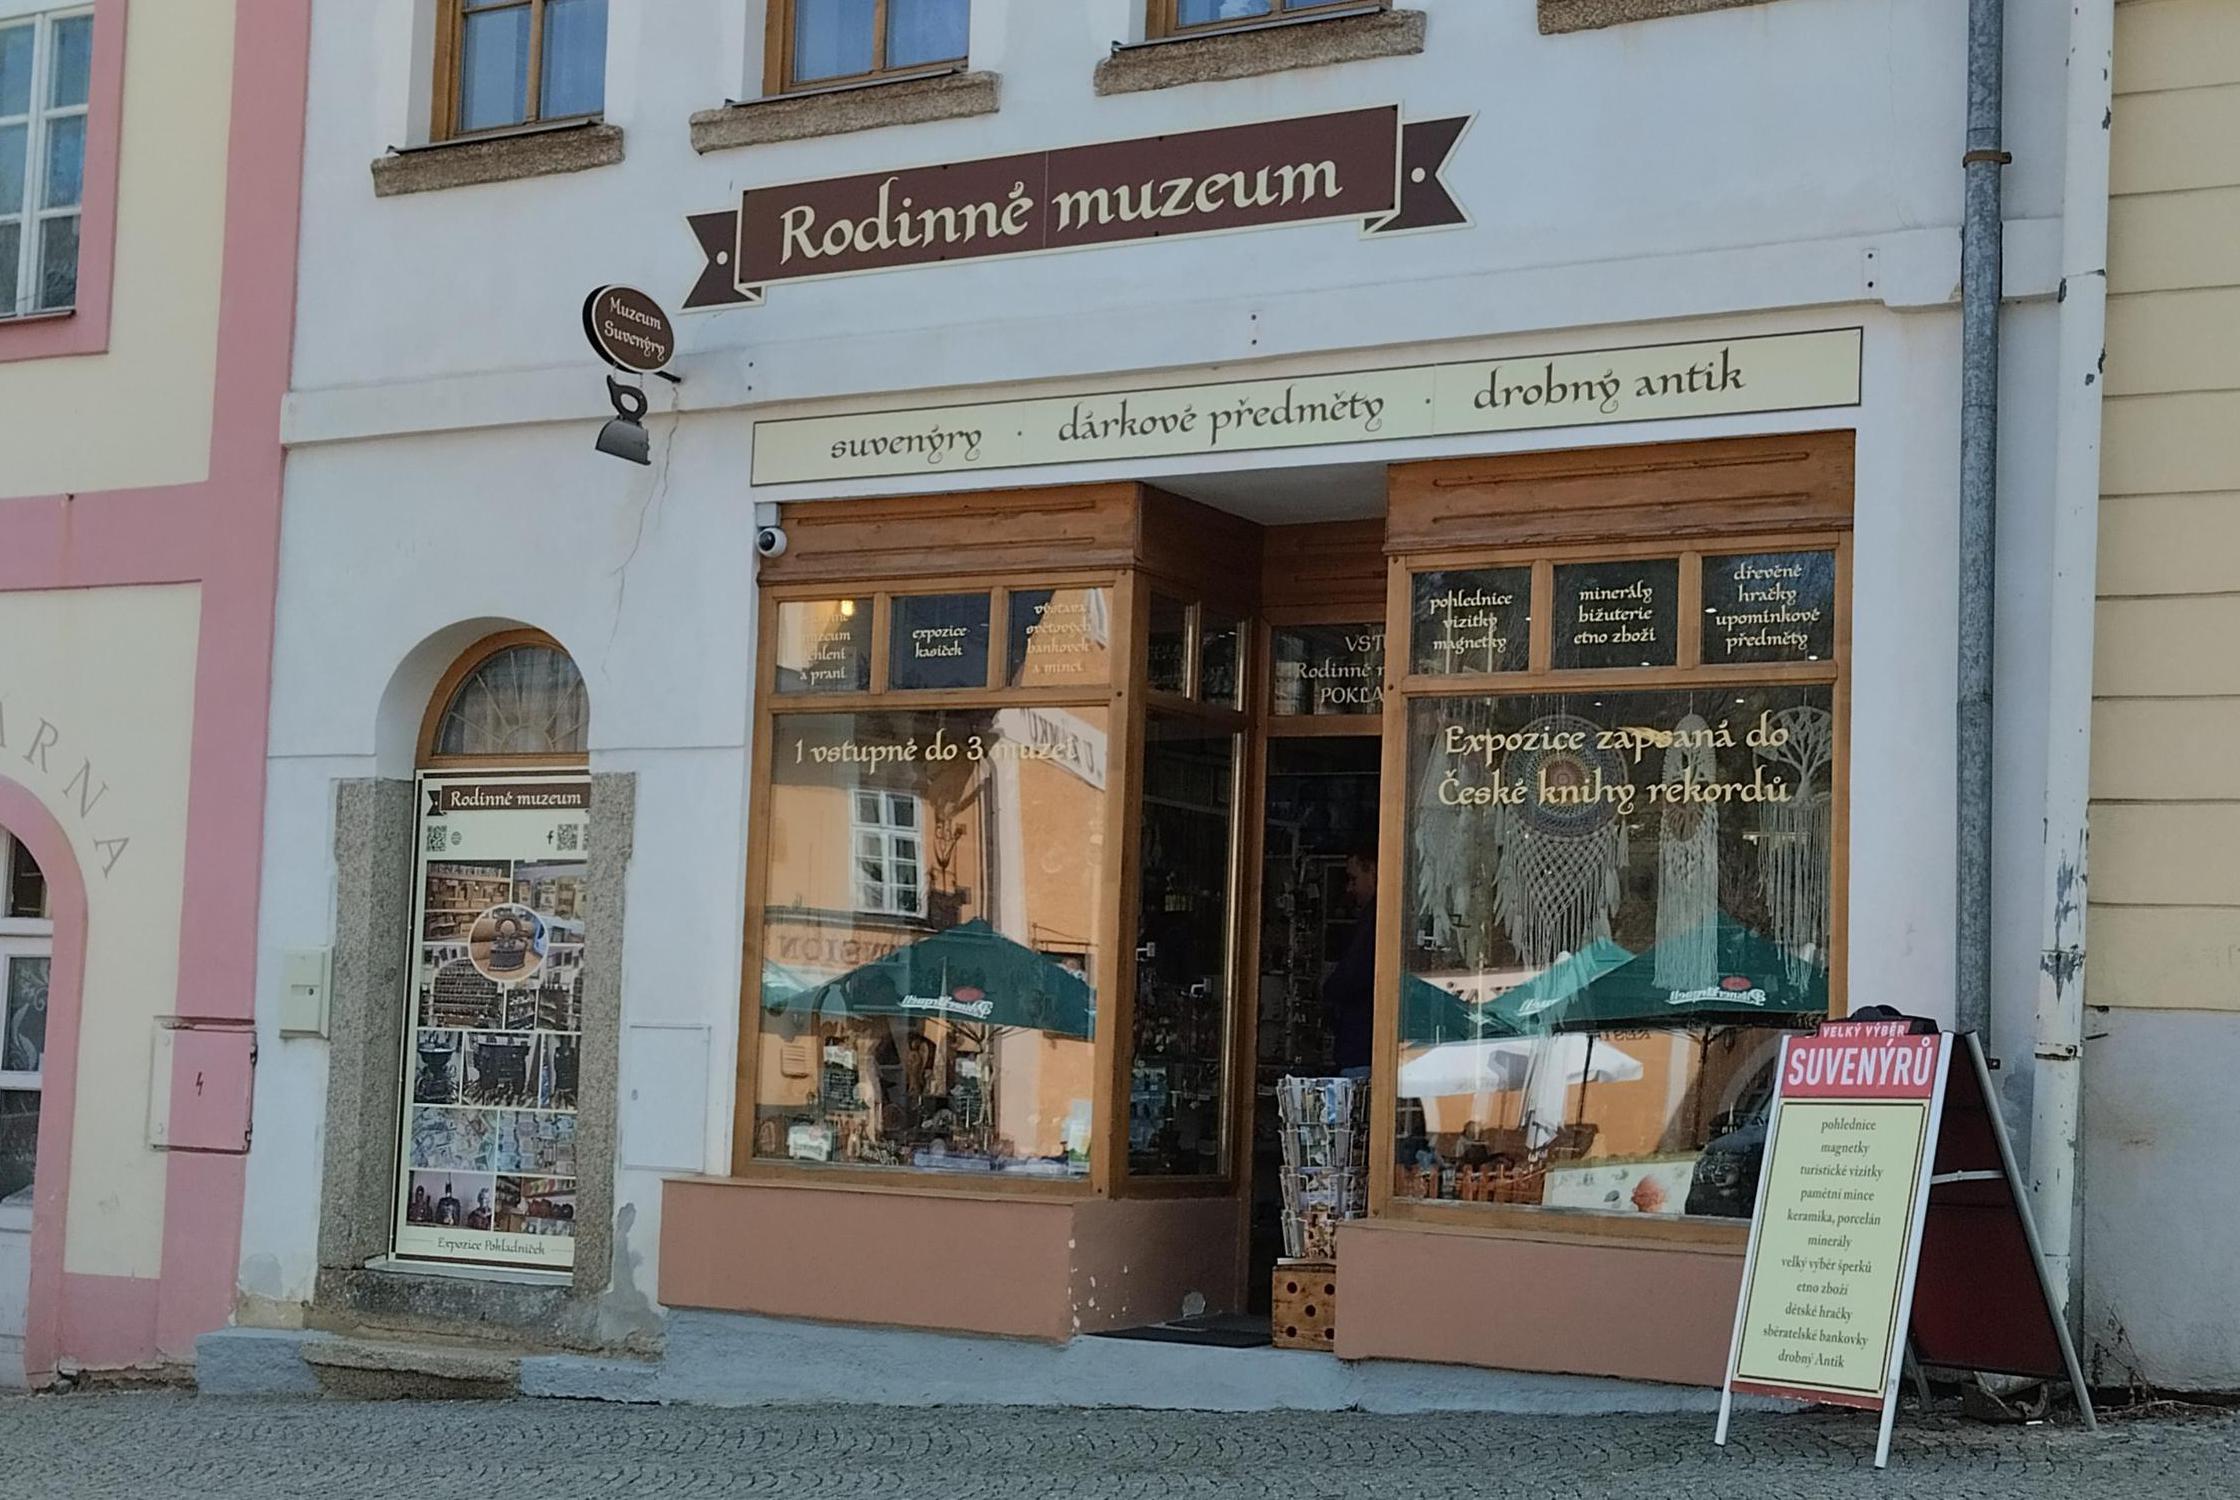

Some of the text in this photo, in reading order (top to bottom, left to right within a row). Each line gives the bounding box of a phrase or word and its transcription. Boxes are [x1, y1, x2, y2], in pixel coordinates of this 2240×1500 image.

[779, 157, 1343, 265] Rodinné muzeum
[609, 296, 661, 331] Muzeum
[604, 320, 665, 362] Suvenýry
[831, 346, 1746, 464] suvenýry dárkové předměty drobný antik
[1733, 562, 1803, 580] dřevěné
[1430, 588, 1513, 615] pohlednice
[1579, 579, 1653, 604] minerály
[1739, 582, 1798, 606] hračky
[1443, 609, 1498, 632] vizitky
[1578, 604, 1653, 623] bižuterie
[1716, 604, 1821, 632] upomínkové
[912, 625, 967, 644] expozice
[1574, 624, 1657, 644] etno zboží
[1725, 627, 1808, 655] předměty
[915, 640, 964, 659] kasiček
[1433, 636, 1507, 655] magnetky
[800, 666, 846, 686] a praní
[1298, 656, 1371, 679] Rodinné
[1445, 709, 1790, 768] Expozice zapsaná do
[810, 738, 918, 775] vstupné
[925, 728, 958, 760] do
[966, 736, 983, 761] 3
[450, 786, 582, 808] Rodinné muzeum
[1438, 765, 1794, 815] České knihy rekordů
[1823, 1021, 1906, 1038] VELKÝ VÝBĚR
[1788, 1036, 1933, 1086] SUVENÝRŮ
[1820, 1117, 1877, 1134] pohlednice
[1821, 1140, 1870, 1157] magnetky
[1800, 1163, 1884, 1181] turistické vizitky
[1843, 1188, 1875, 1201] mince
[1787, 1208, 1881, 1228] keramika, porcelán
[437, 1236, 482, 1254] Expozice
[1808, 1234, 1853, 1251] minerály
[1838, 1259, 1872, 1276] šperků
[1796, 1281, 1849, 1296] etno zboží
[1818, 1304, 1853, 1324] hračky
[1819, 1328, 1869, 1350] bankovky
[1815, 1352, 1845, 1368] Antik
